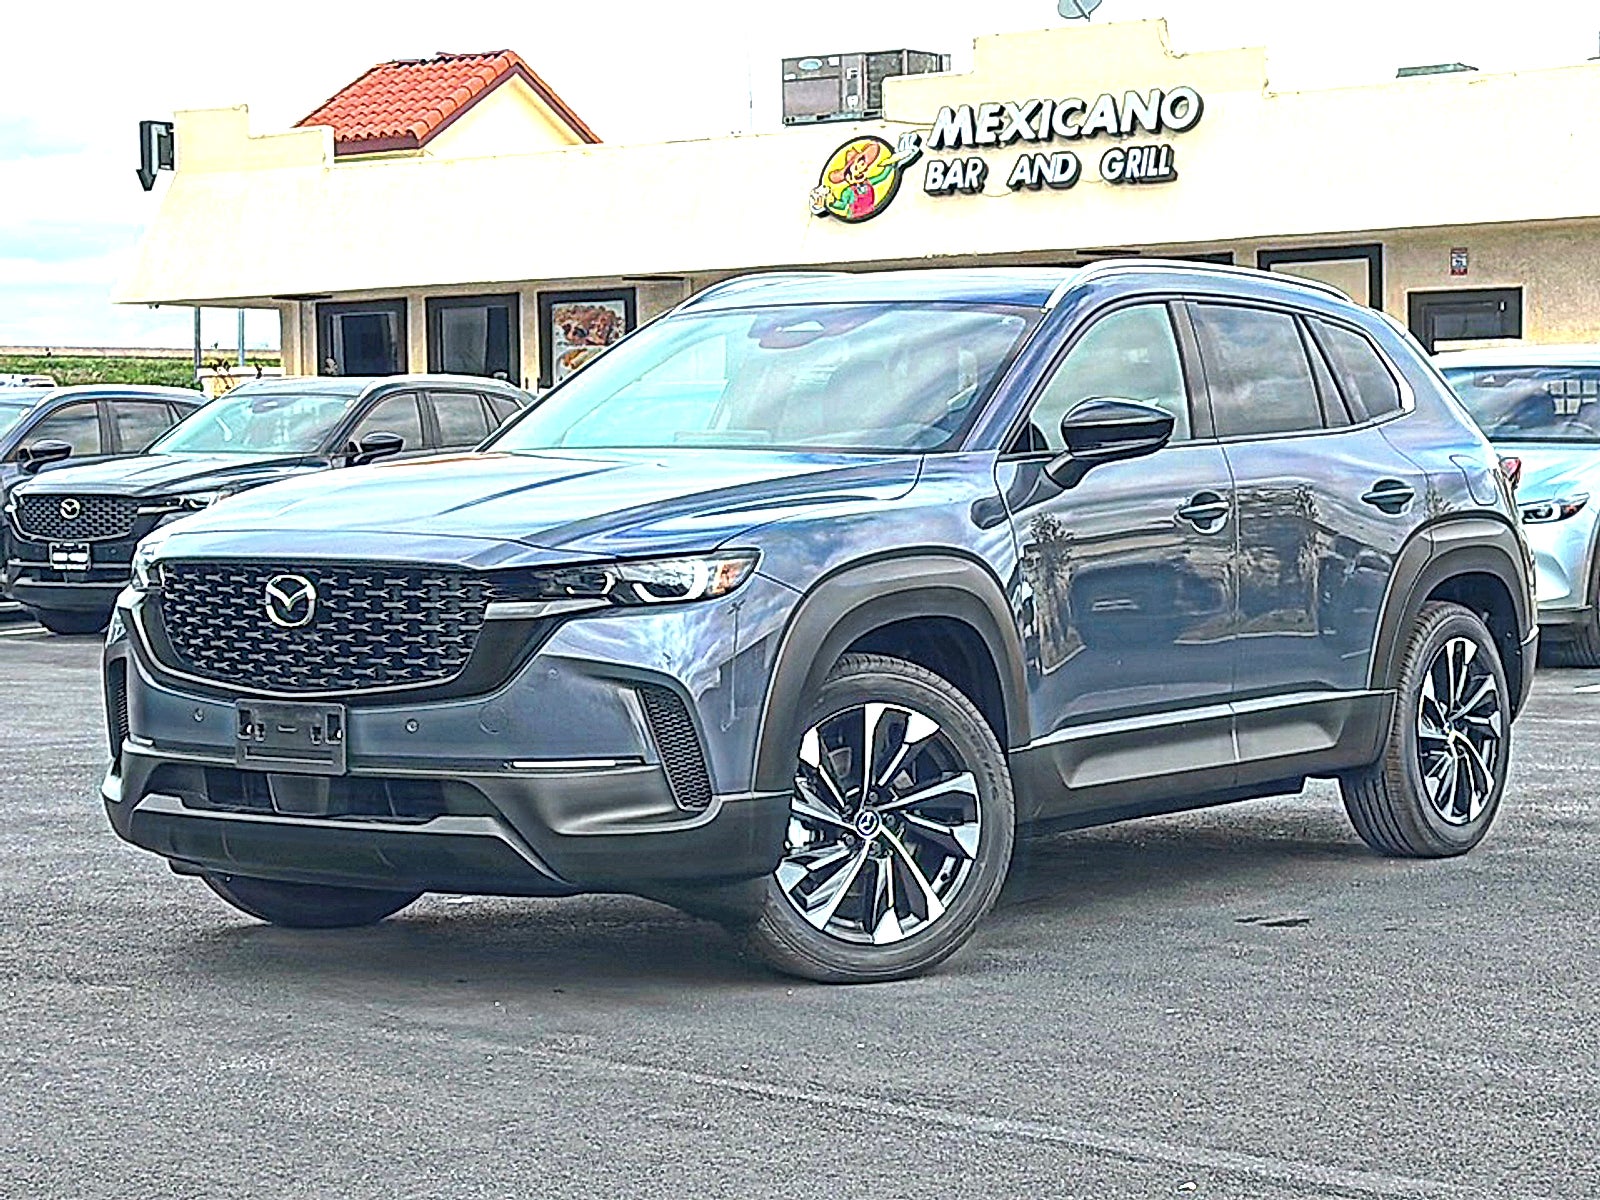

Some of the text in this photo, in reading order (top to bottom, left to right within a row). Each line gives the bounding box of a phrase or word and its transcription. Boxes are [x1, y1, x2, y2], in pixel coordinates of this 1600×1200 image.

[928, 86, 1203, 148] MEXICANO
[925, 145, 1176, 195] BAR AND GRILL
